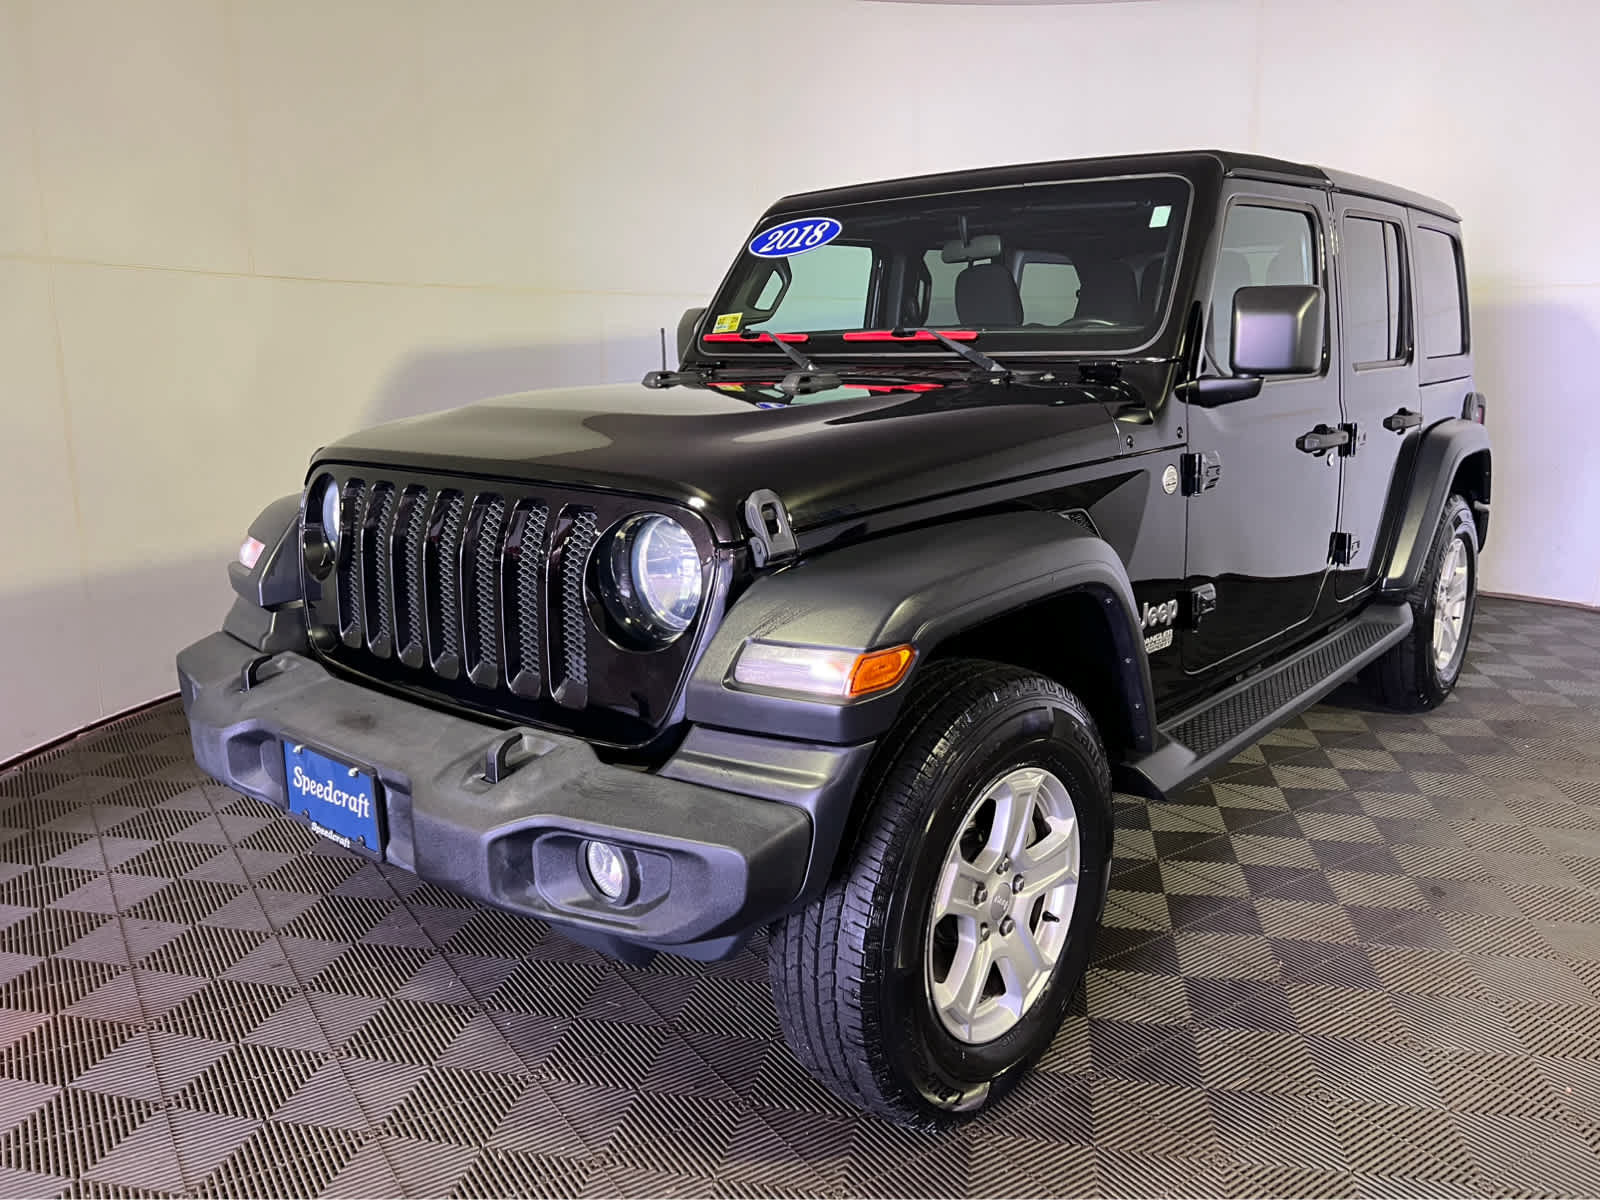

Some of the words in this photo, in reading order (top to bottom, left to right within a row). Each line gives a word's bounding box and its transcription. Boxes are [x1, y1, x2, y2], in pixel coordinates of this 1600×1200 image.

[758, 221, 831, 253] 2018
[1140, 599, 1178, 630] Jeep
[293, 765, 370, 818] Speedcraft
[311, 821, 351, 849] Speedcraft
